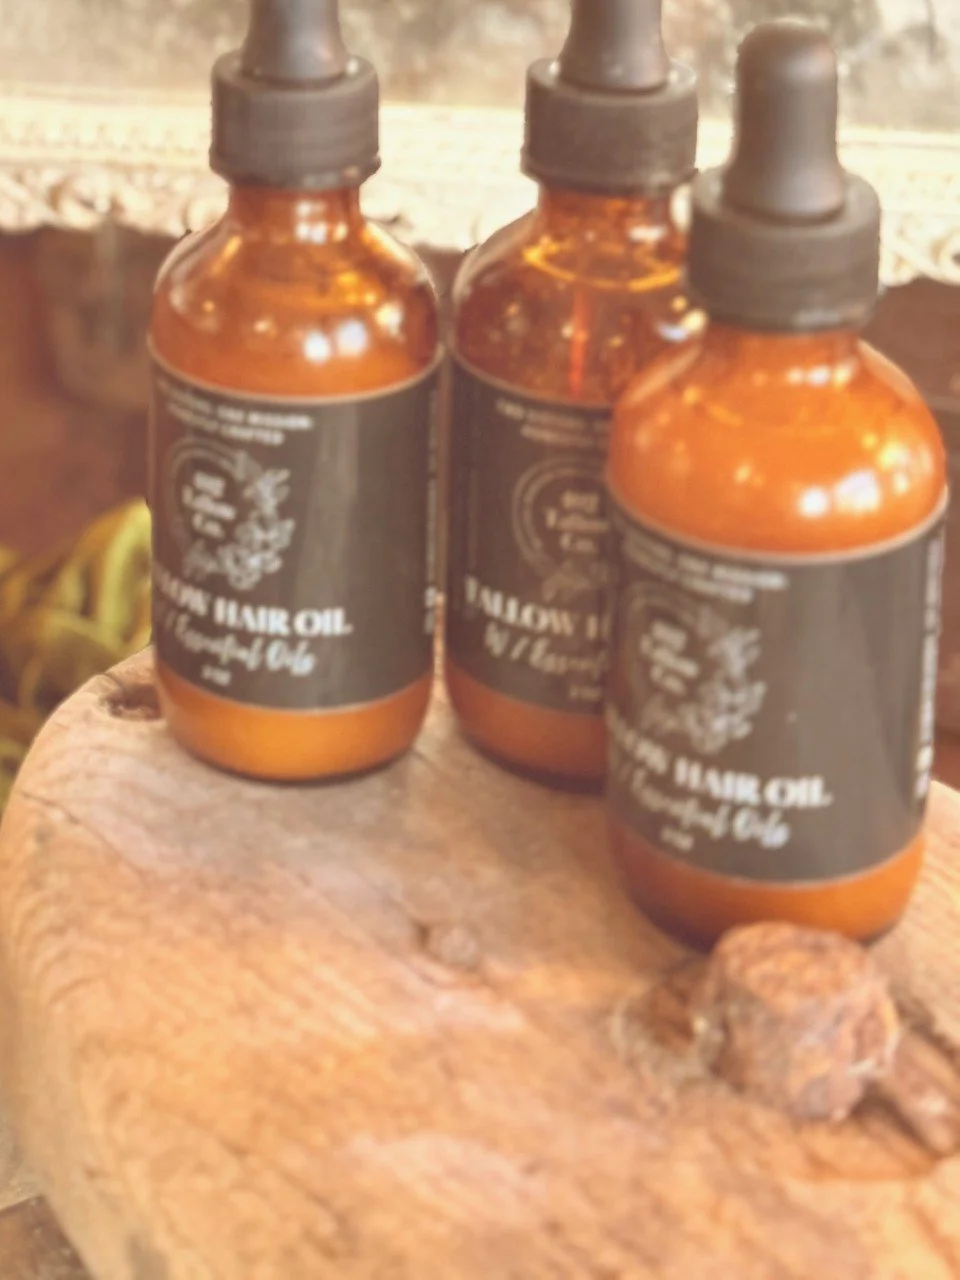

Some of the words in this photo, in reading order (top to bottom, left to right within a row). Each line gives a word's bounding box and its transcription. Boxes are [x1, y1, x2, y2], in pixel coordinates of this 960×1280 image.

[214, 596, 290, 637] HAIR
[294, 606, 354, 637] OIL
[464, 575, 581, 638] TALLOW
[674, 755, 762, 807] HAIR
[764, 774, 834, 809] OIL
